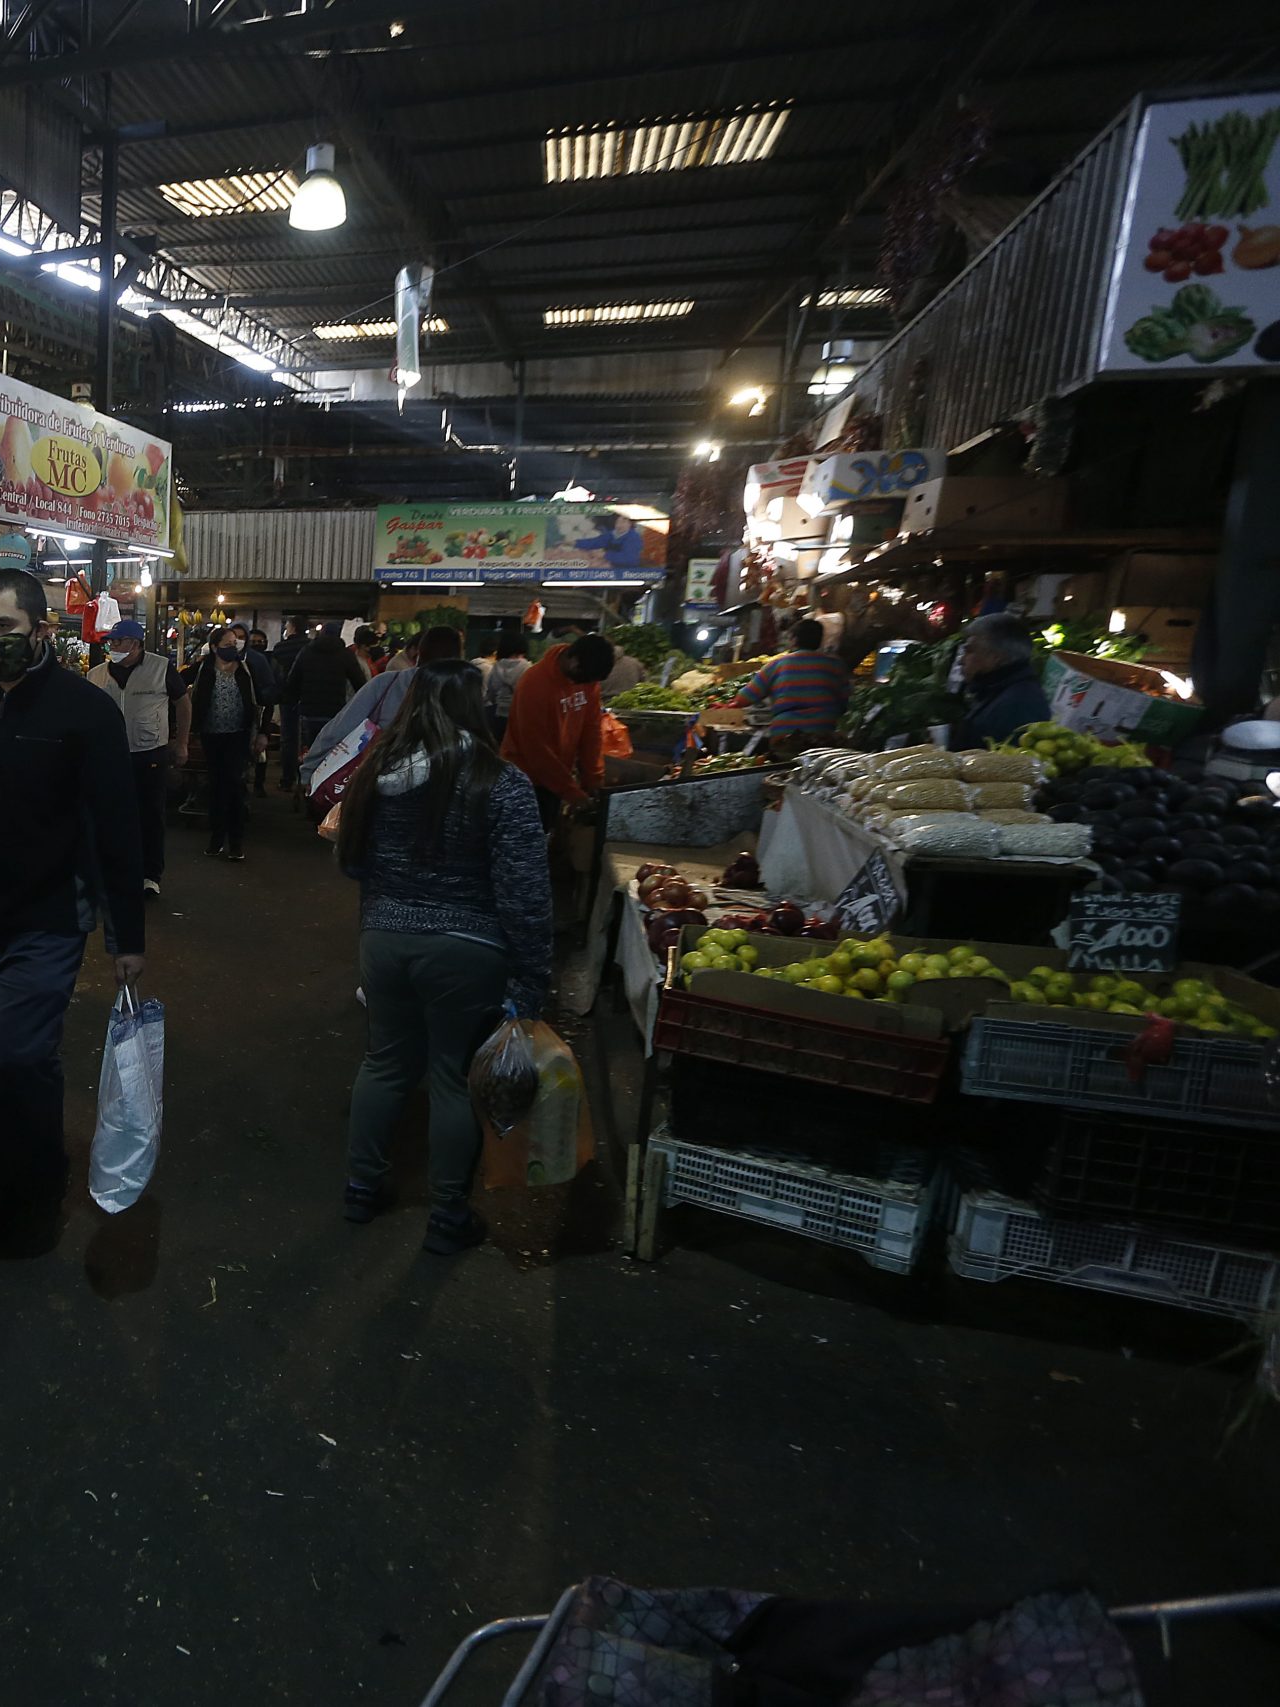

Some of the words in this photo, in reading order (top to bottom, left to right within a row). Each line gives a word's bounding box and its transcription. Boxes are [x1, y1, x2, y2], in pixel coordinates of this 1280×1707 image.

[48, 415, 61, 433] de
[63, 417, 93, 444] Frutas
[93, 432, 101, 448] y
[101, 432, 136, 459] Verduras
[49, 439, 87, 468] Frutas
[47, 458, 87, 494] MC
[35, 497, 56, 512] Local
[57, 502, 72, 515] 844
[79, 507, 96, 521] Fono
[97, 511, 113, 524] 2735
[115, 515, 130, 528] 7015
[449, 506, 504, 517] VERDURAS
[386, 517, 444, 535] Gaspar
[478, 560, 520, 570] Reparto
[431, 570, 452, 579] Local
[484, 571, 504, 581] Vega
